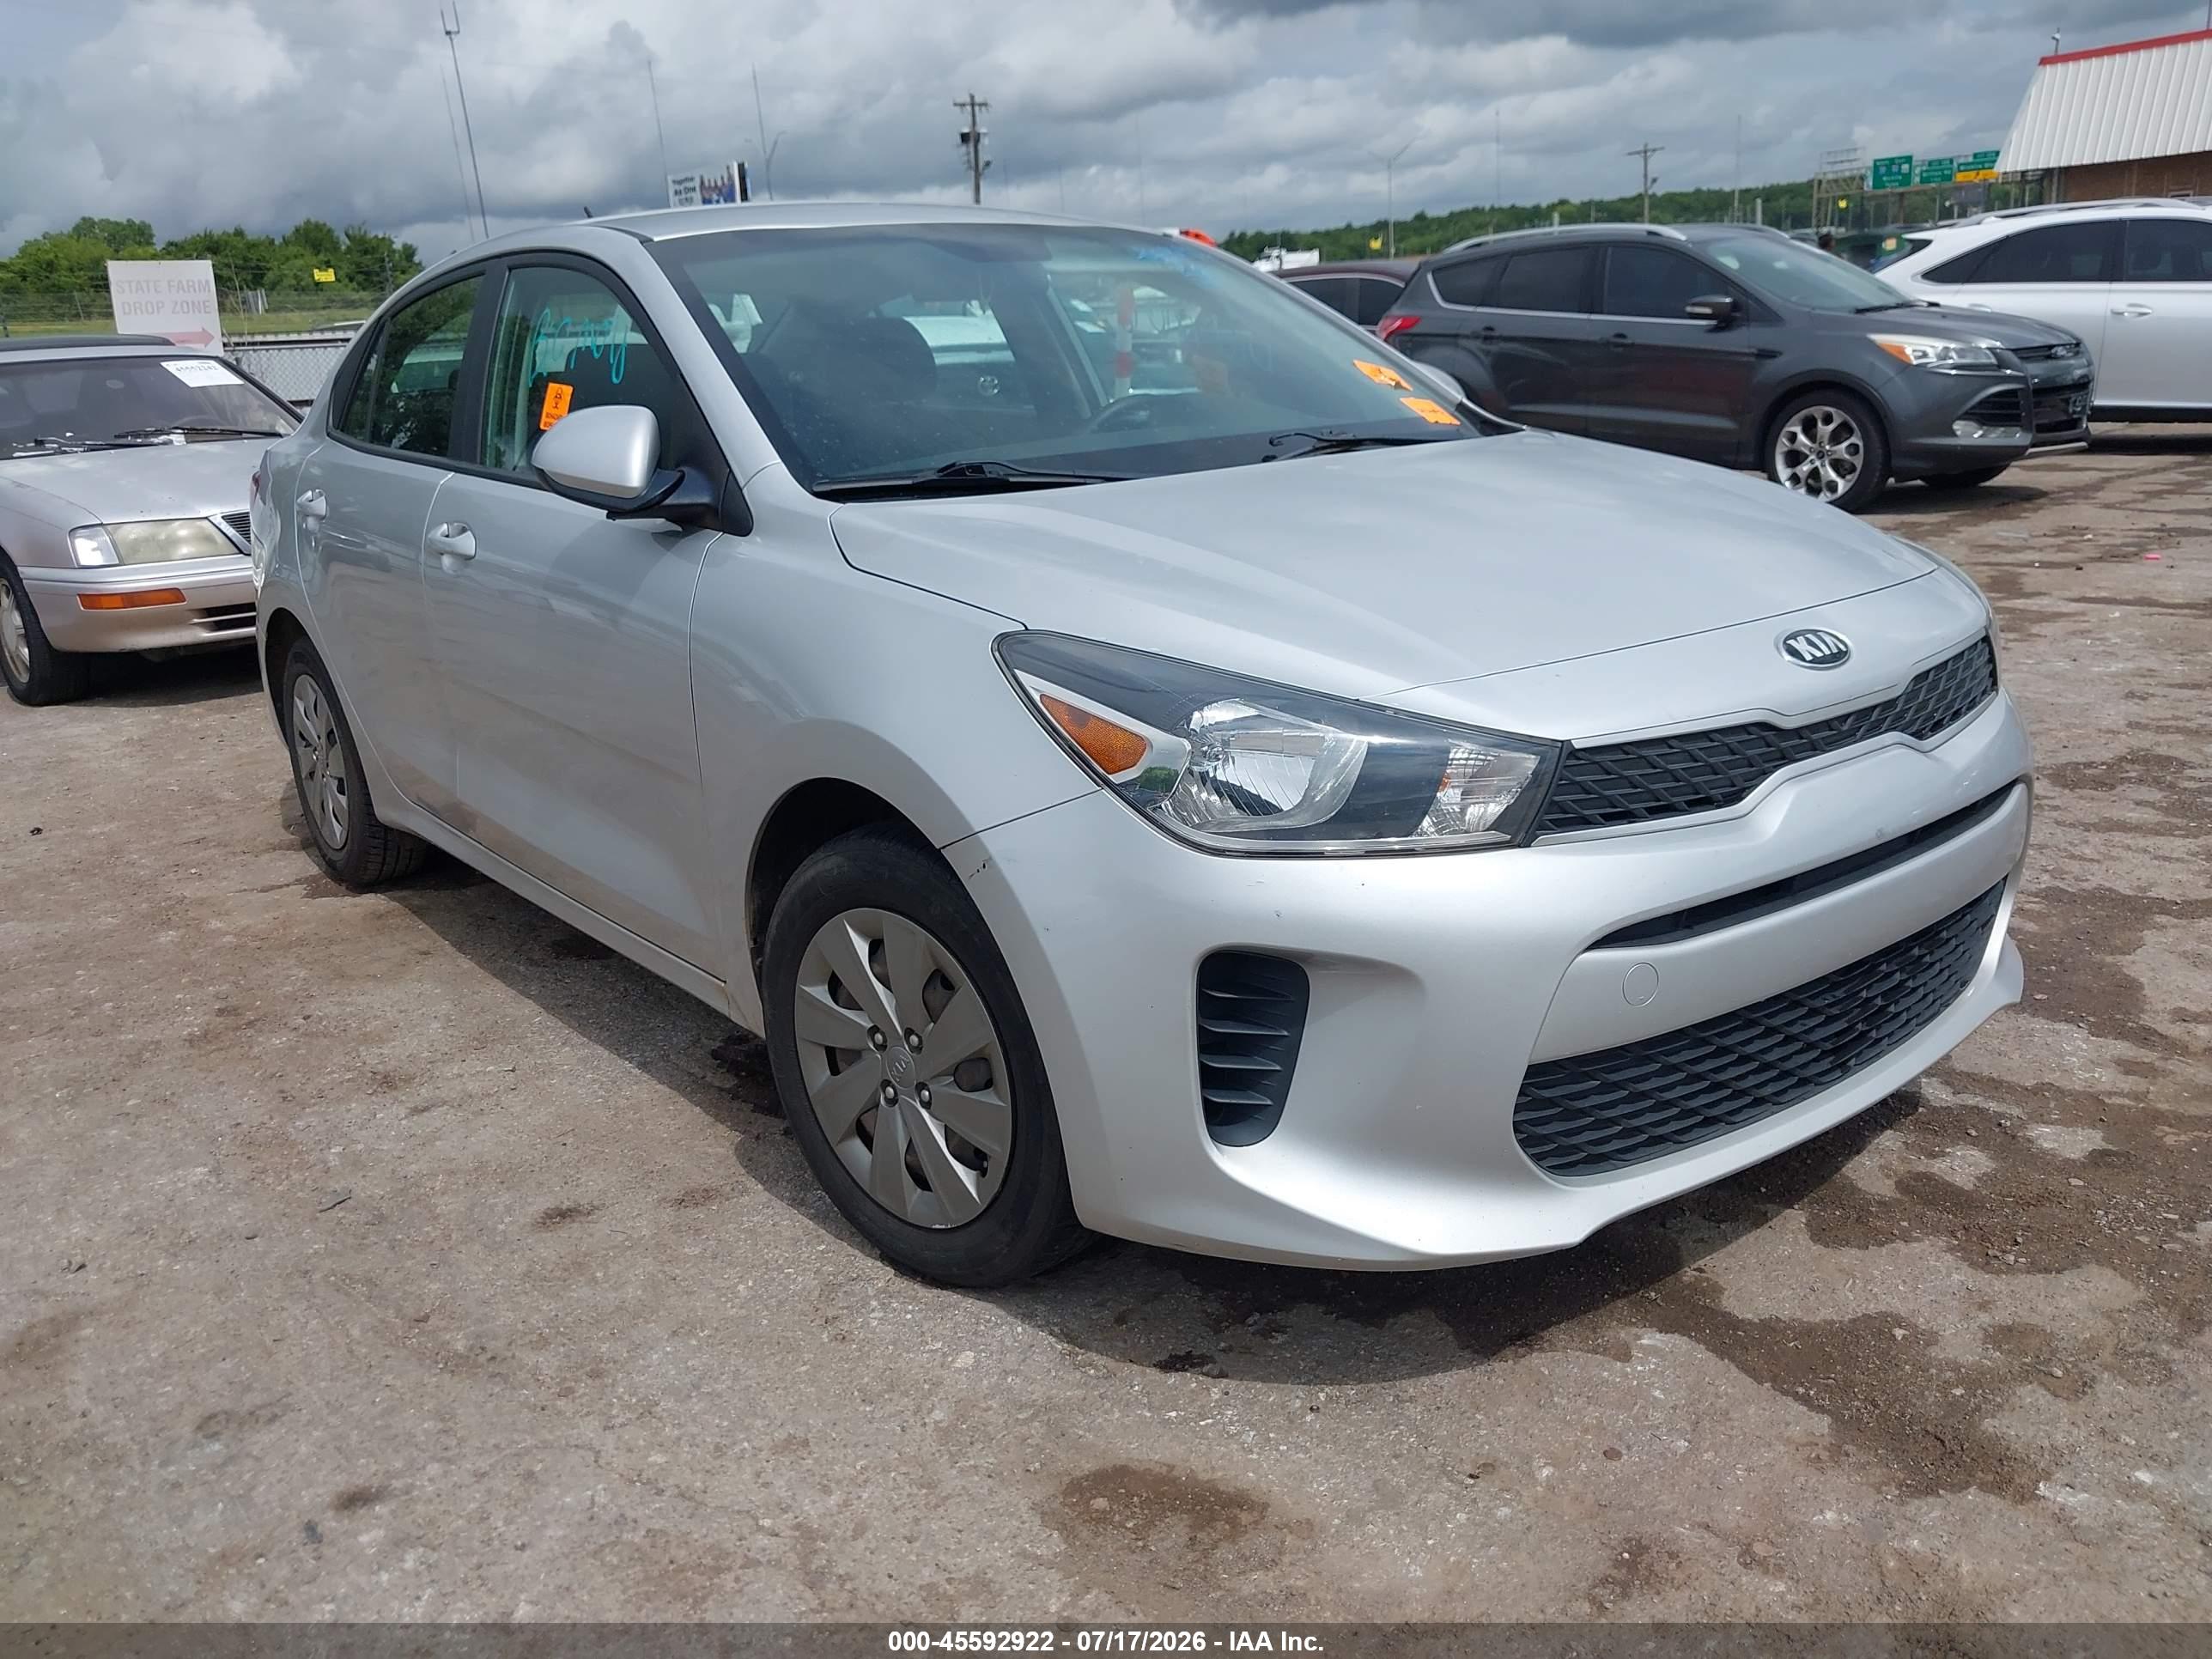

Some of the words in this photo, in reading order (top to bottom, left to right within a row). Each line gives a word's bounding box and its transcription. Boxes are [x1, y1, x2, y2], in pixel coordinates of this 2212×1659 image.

[115, 279, 161, 295] STATE
[167, 279, 211, 294] FARM
[122, 301, 165, 316] DROP
[171, 300, 212, 314] ZONE
[1786, 632, 1848, 661] KIA
